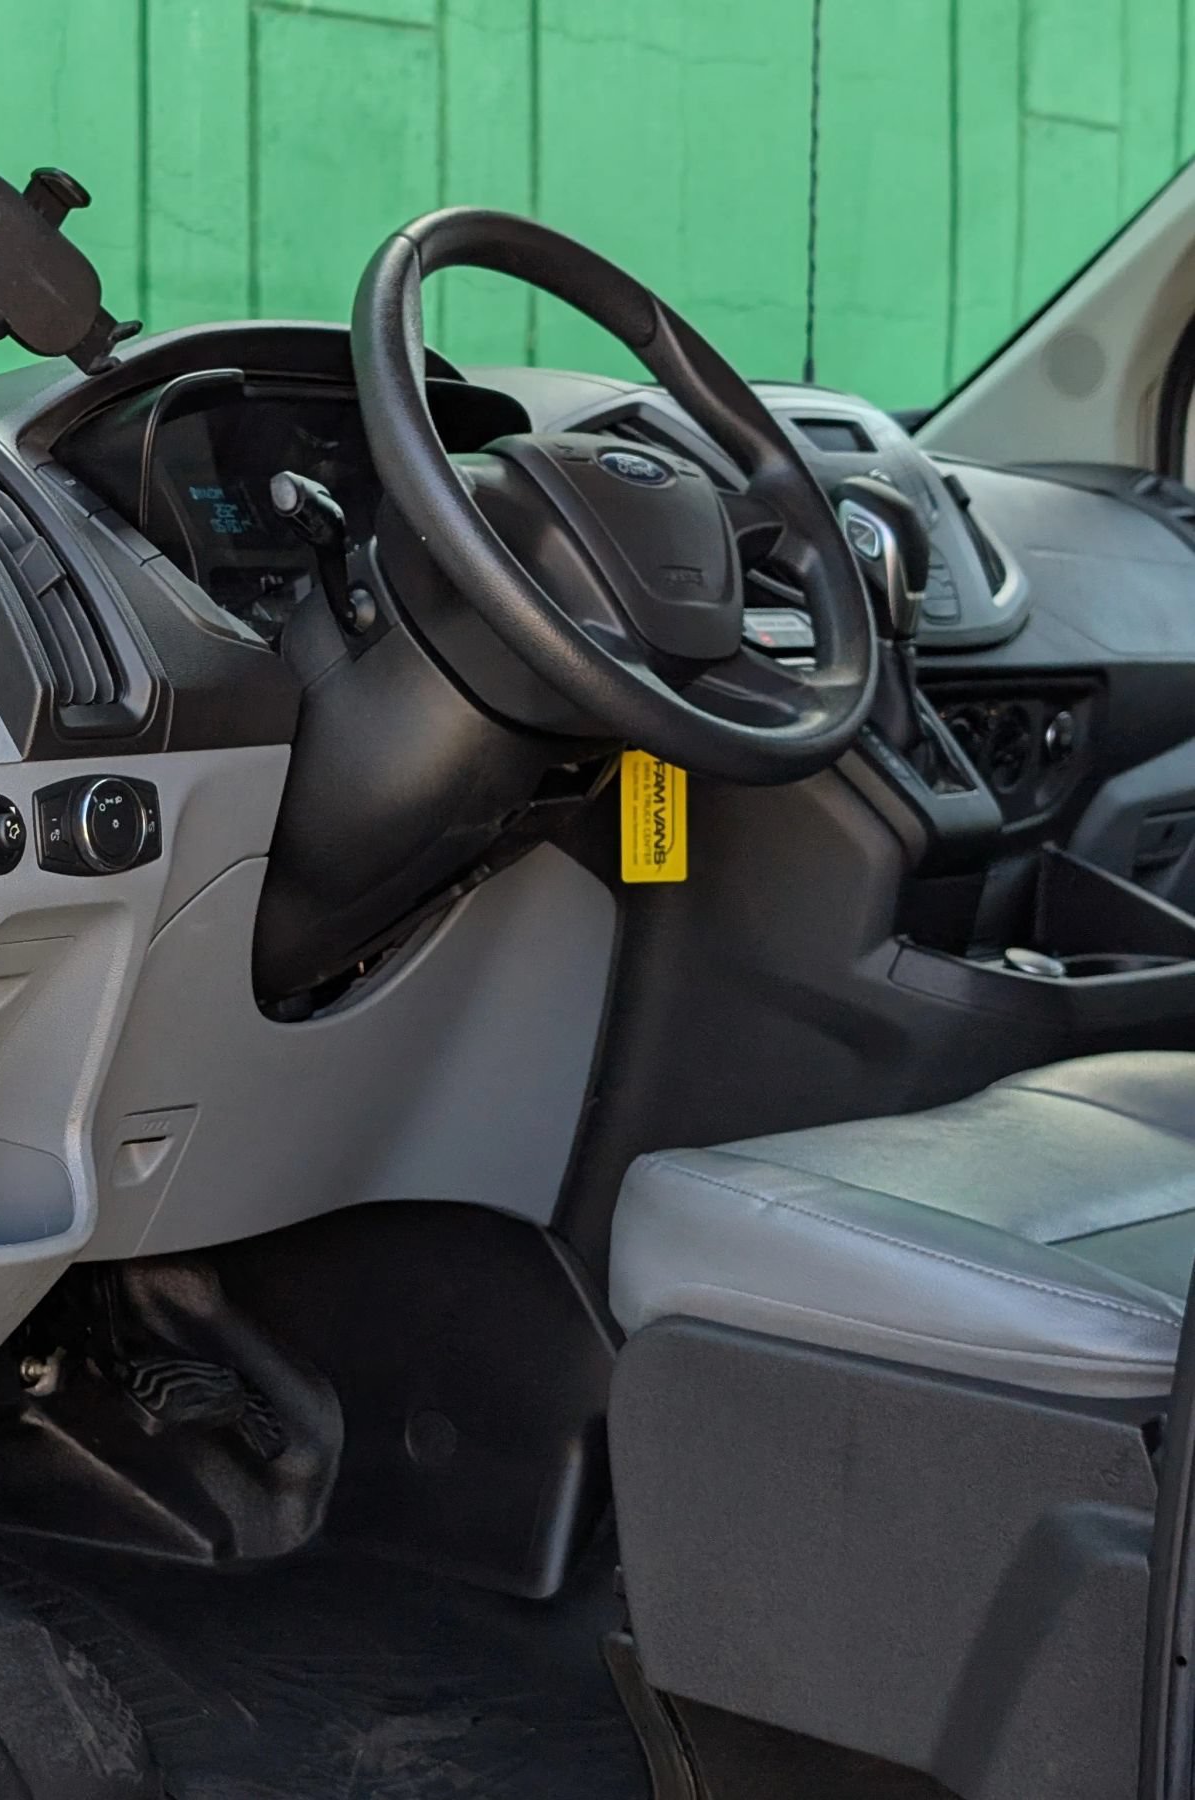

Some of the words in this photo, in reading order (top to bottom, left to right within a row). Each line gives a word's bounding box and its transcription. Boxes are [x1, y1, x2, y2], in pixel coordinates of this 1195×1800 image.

[616, 456, 657, 478] Ford
[653, 761, 666, 803] FAM
[653, 806, 666, 865] VANS
